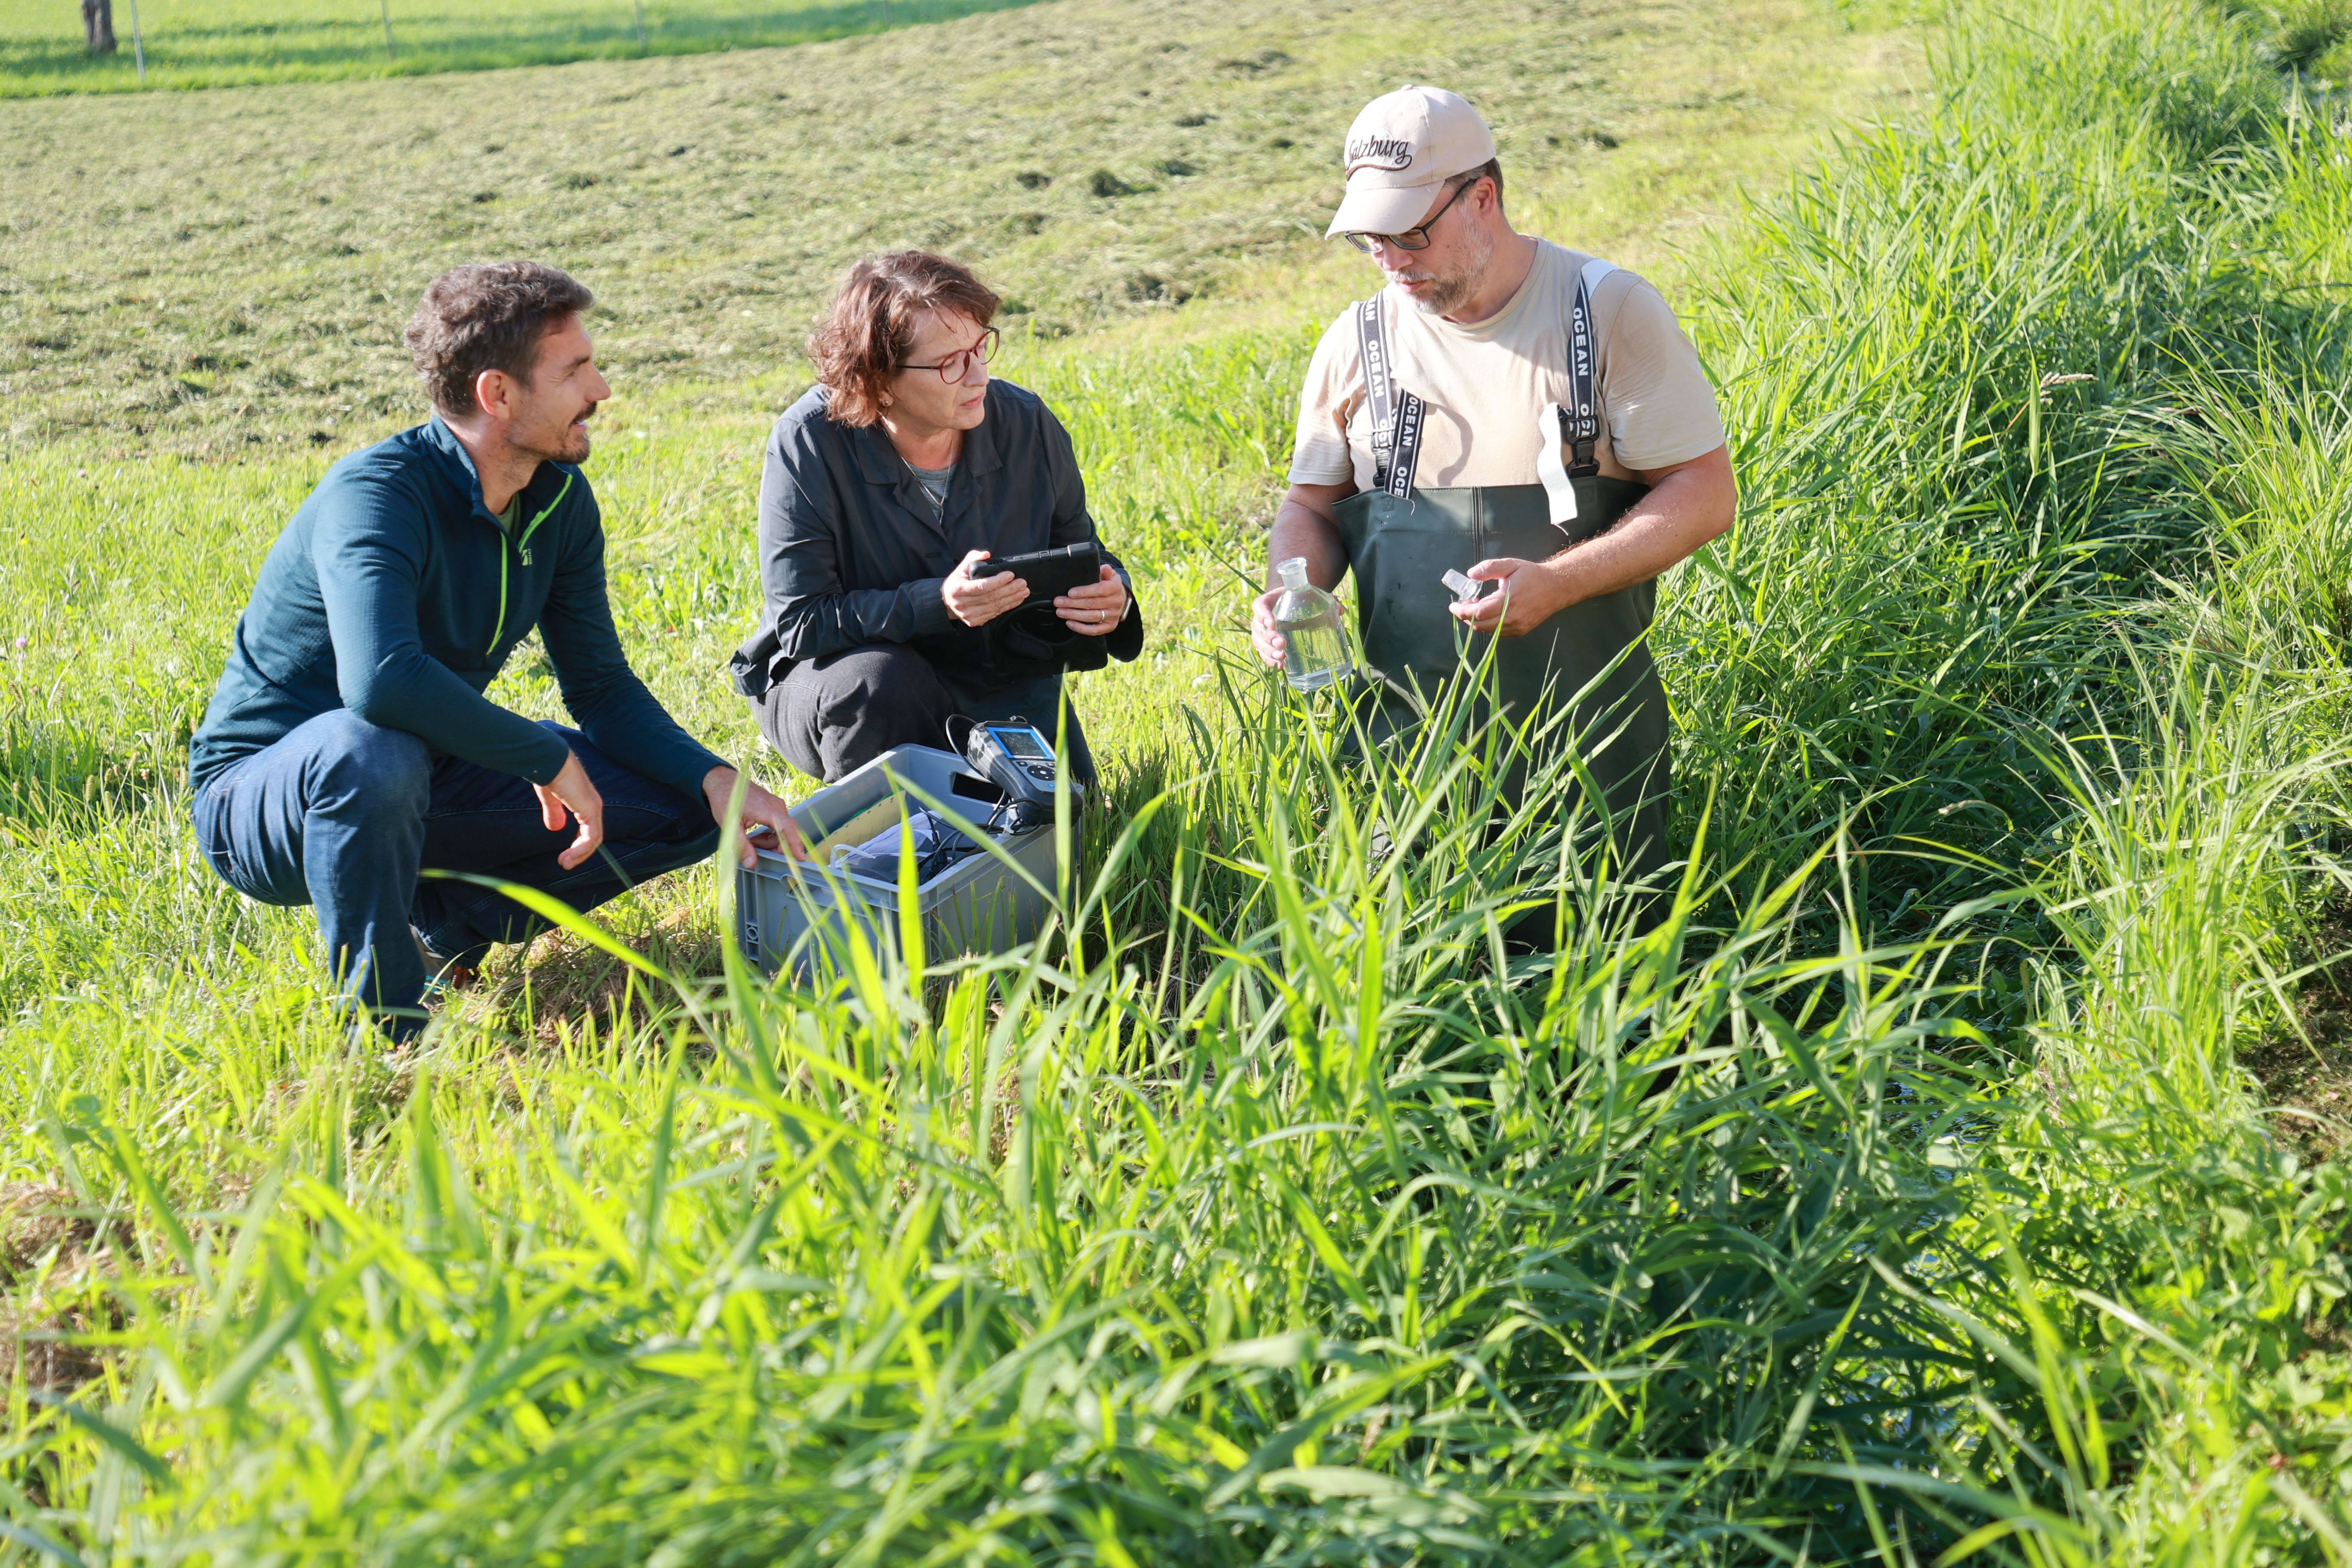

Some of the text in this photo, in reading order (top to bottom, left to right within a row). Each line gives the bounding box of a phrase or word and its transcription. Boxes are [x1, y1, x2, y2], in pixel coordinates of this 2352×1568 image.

[1347, 135, 1412, 168] Salzburg
[1365, 293, 1377, 321] EAN
[1573, 307, 1588, 377] OCEAN
[1368, 340, 1384, 398] OCEAN
[1400, 396, 1418, 447] OCEAN
[1394, 467, 1408, 497] OCE
